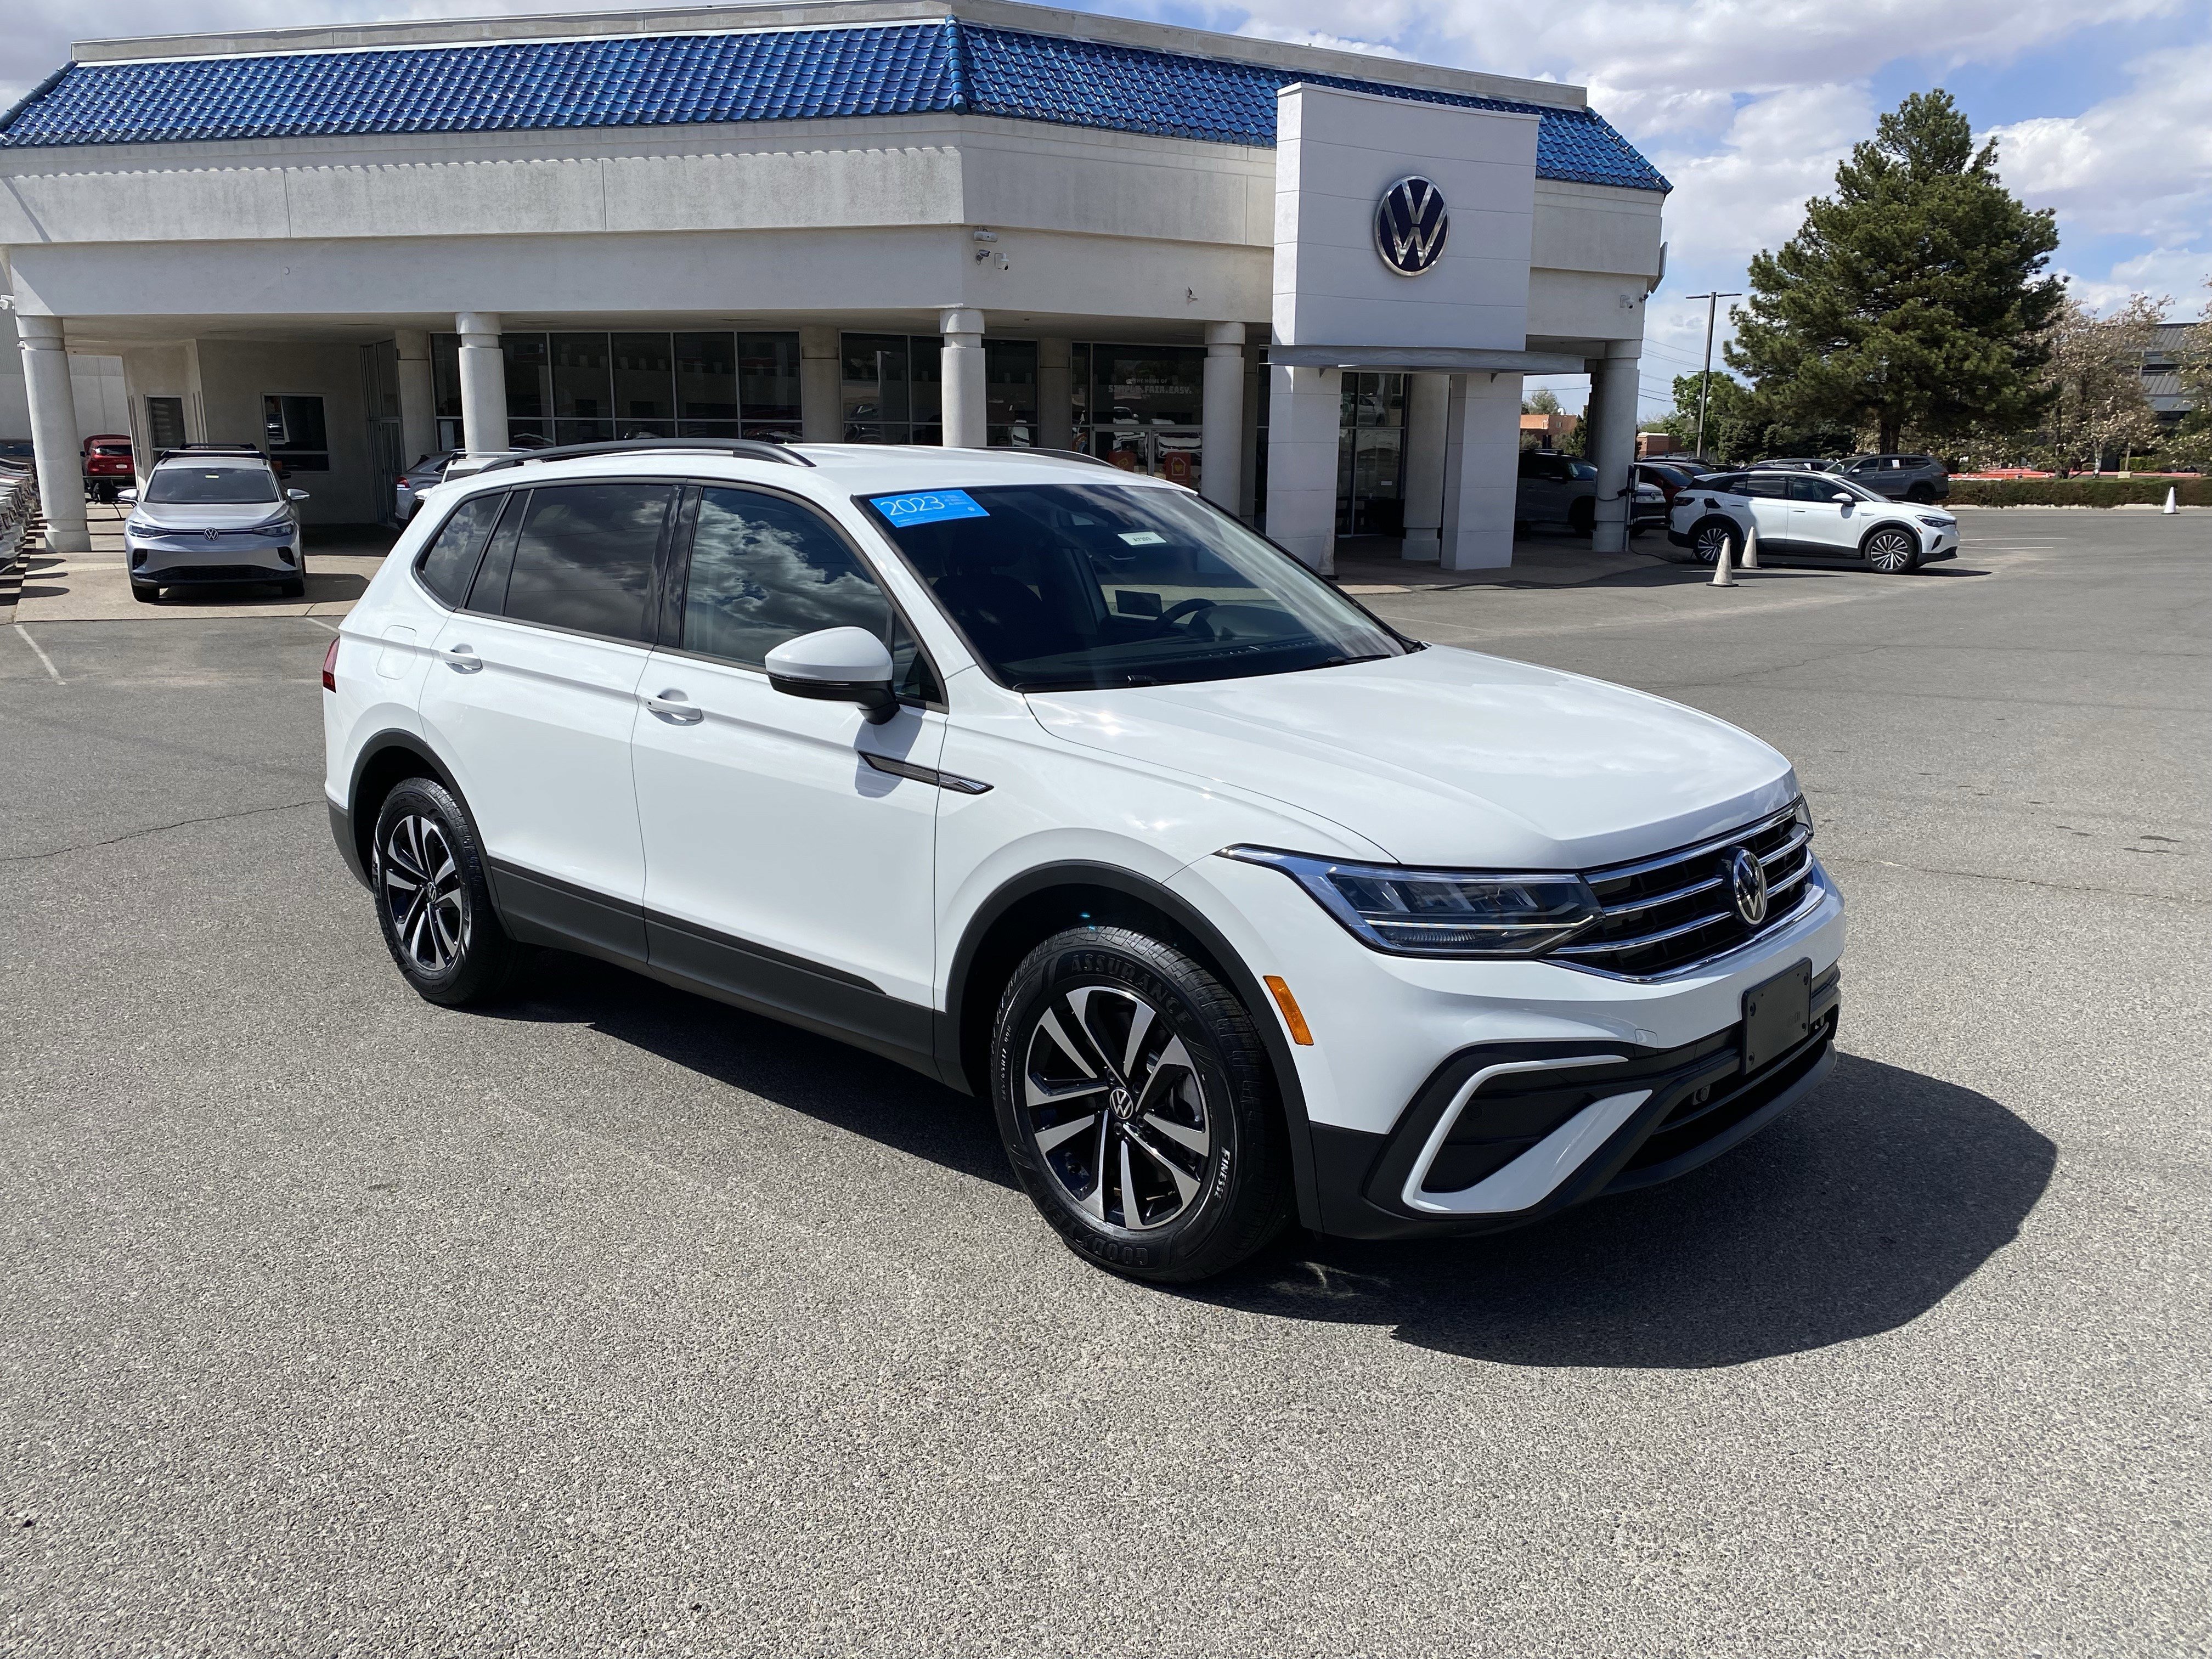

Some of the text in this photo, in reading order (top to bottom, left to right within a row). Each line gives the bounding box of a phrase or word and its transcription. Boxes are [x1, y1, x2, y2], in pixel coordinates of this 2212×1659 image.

[880, 496, 945, 516] 2023
[1071, 953, 1193, 1024] ASSURANCE
[1214, 1146, 1230, 1201] FINESSE
